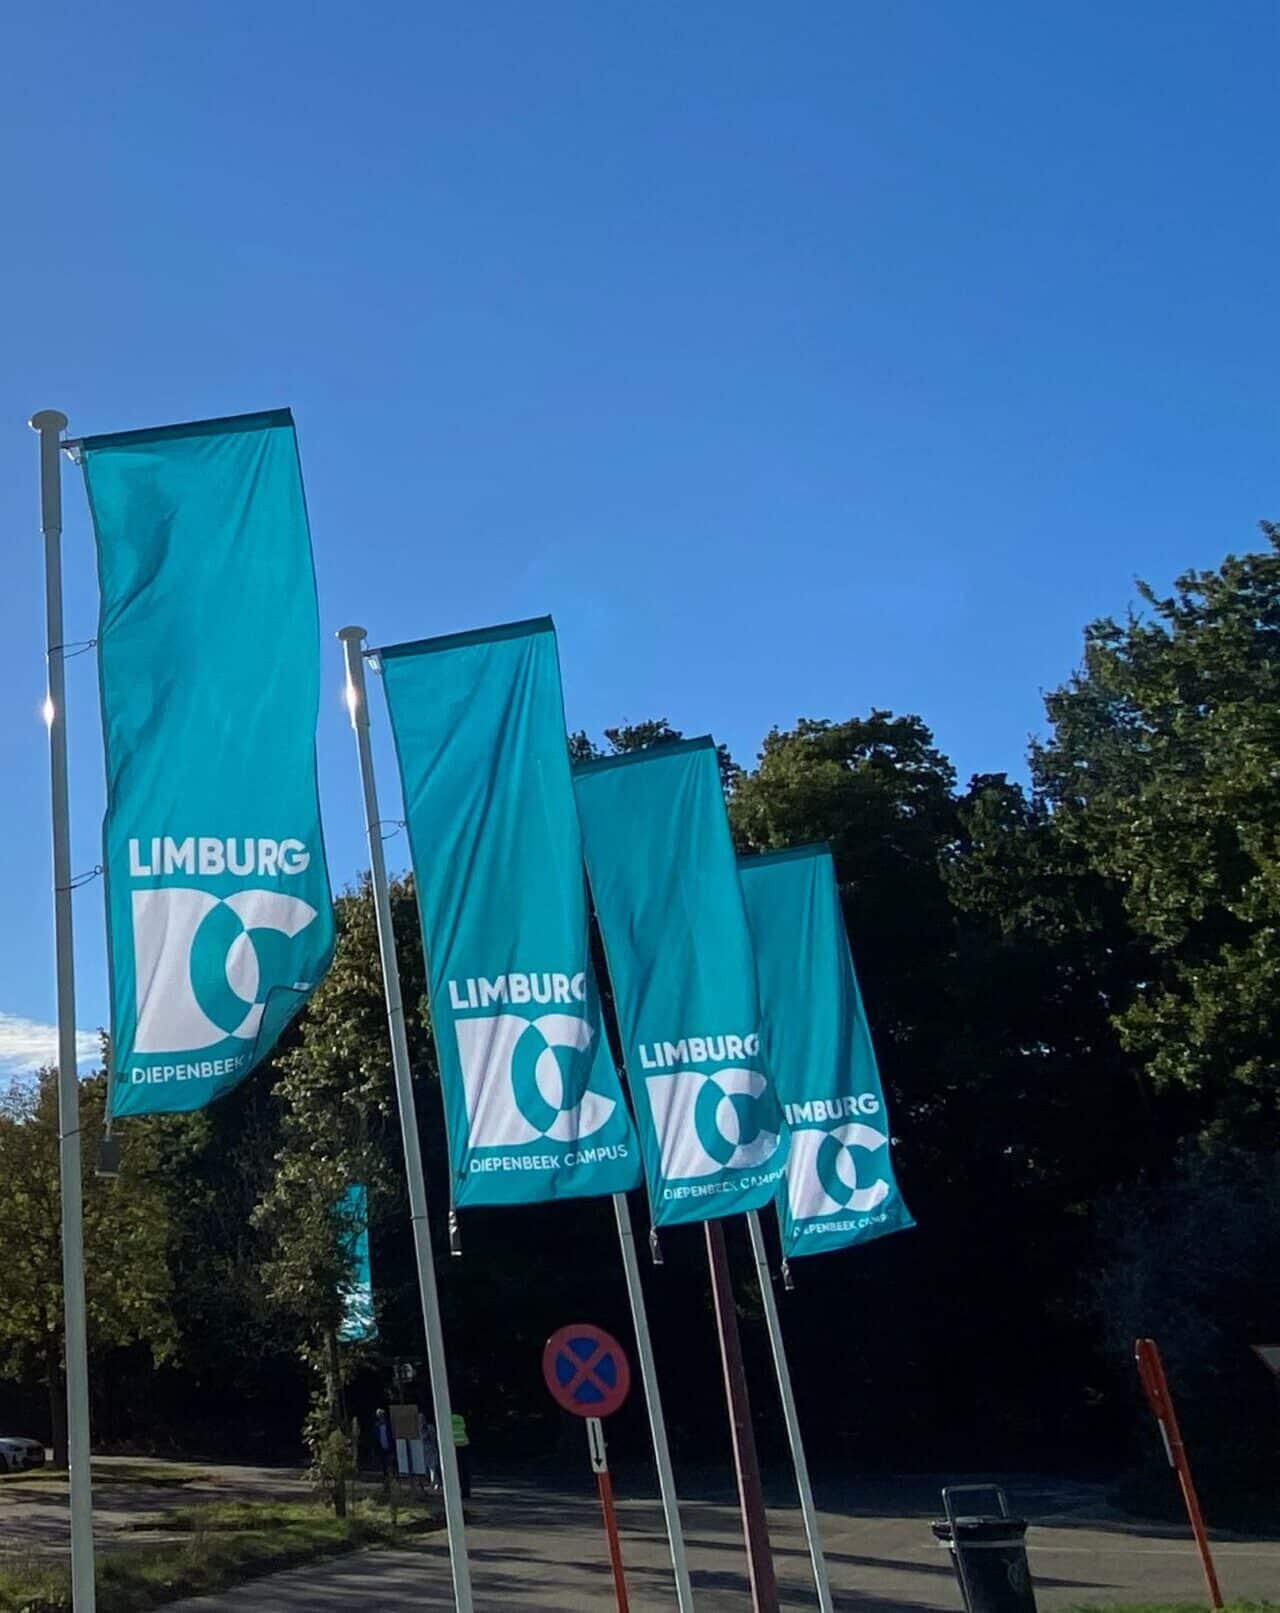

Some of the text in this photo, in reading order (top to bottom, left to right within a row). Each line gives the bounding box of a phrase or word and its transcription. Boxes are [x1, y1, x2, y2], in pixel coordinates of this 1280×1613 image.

[128, 836, 310, 877] LIMBURG
[638, 1033, 760, 1068] LIMBURG
[131, 1054, 245, 1084] DIEPENBEEK
[784, 1092, 880, 1126] IMBURG
[470, 1144, 628, 1174] DIEPENBEEK CAMPUS
[739, 1166, 785, 1190] CAMPU
